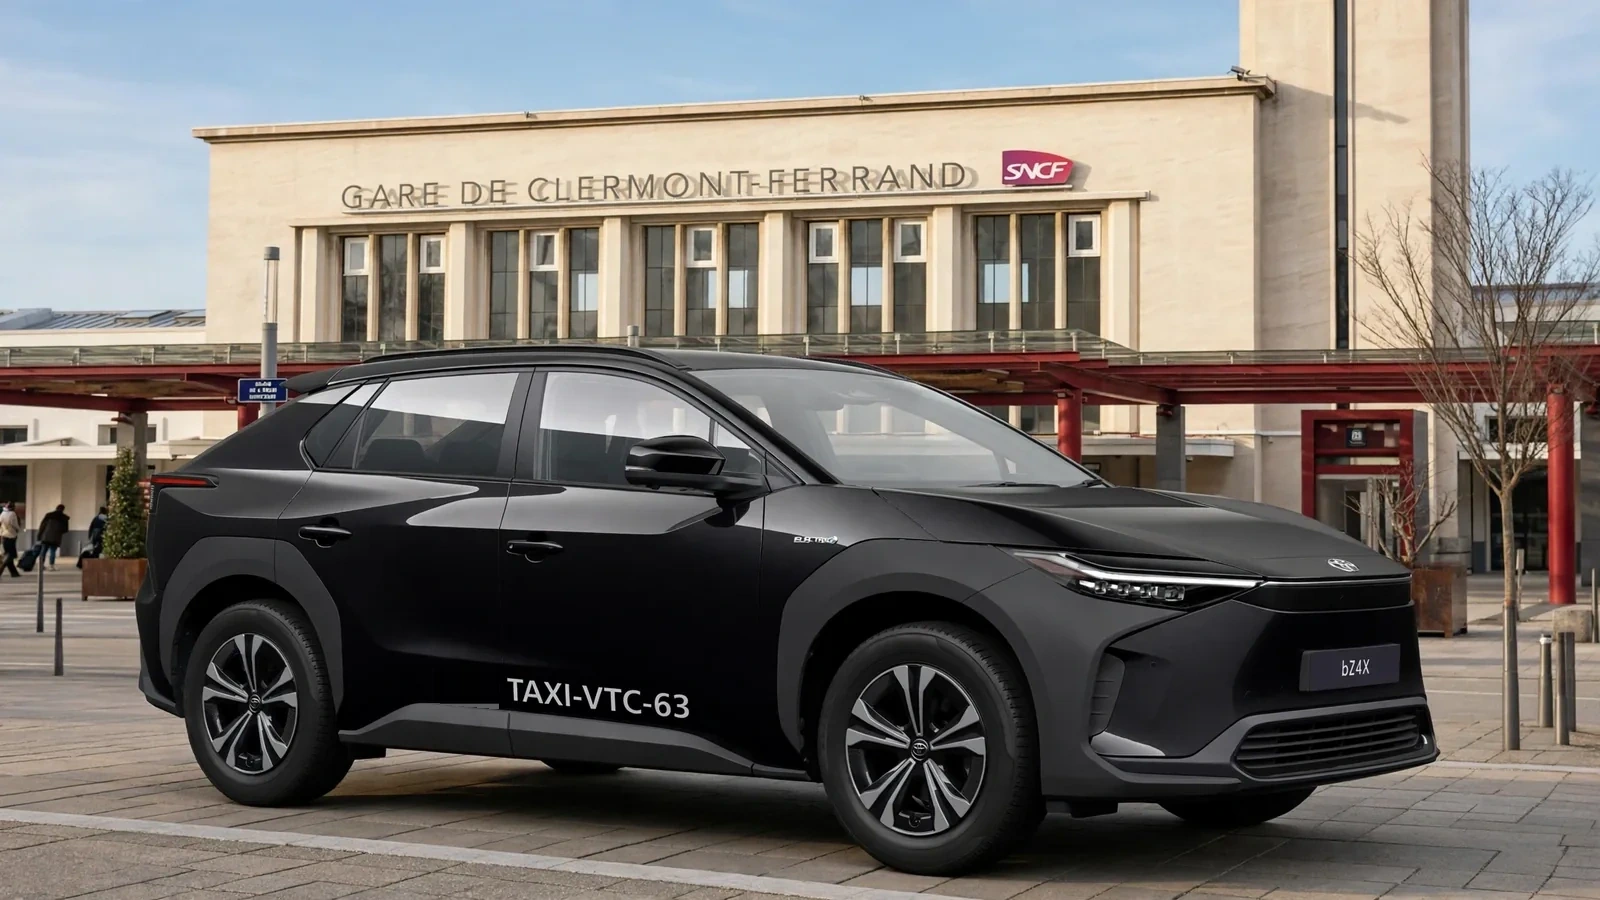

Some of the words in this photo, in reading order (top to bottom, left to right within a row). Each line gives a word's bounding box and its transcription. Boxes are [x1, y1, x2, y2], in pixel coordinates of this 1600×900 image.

[341, 182, 438, 209] GARE
[461, 180, 506, 205] DE
[528, 162, 965, 203] CLERMONT-FERRAND
[1004, 162, 1068, 180] SNCF
[1341, 659, 1370, 677] bZ4X
[507, 677, 690, 719] TAXI-VTC-63
